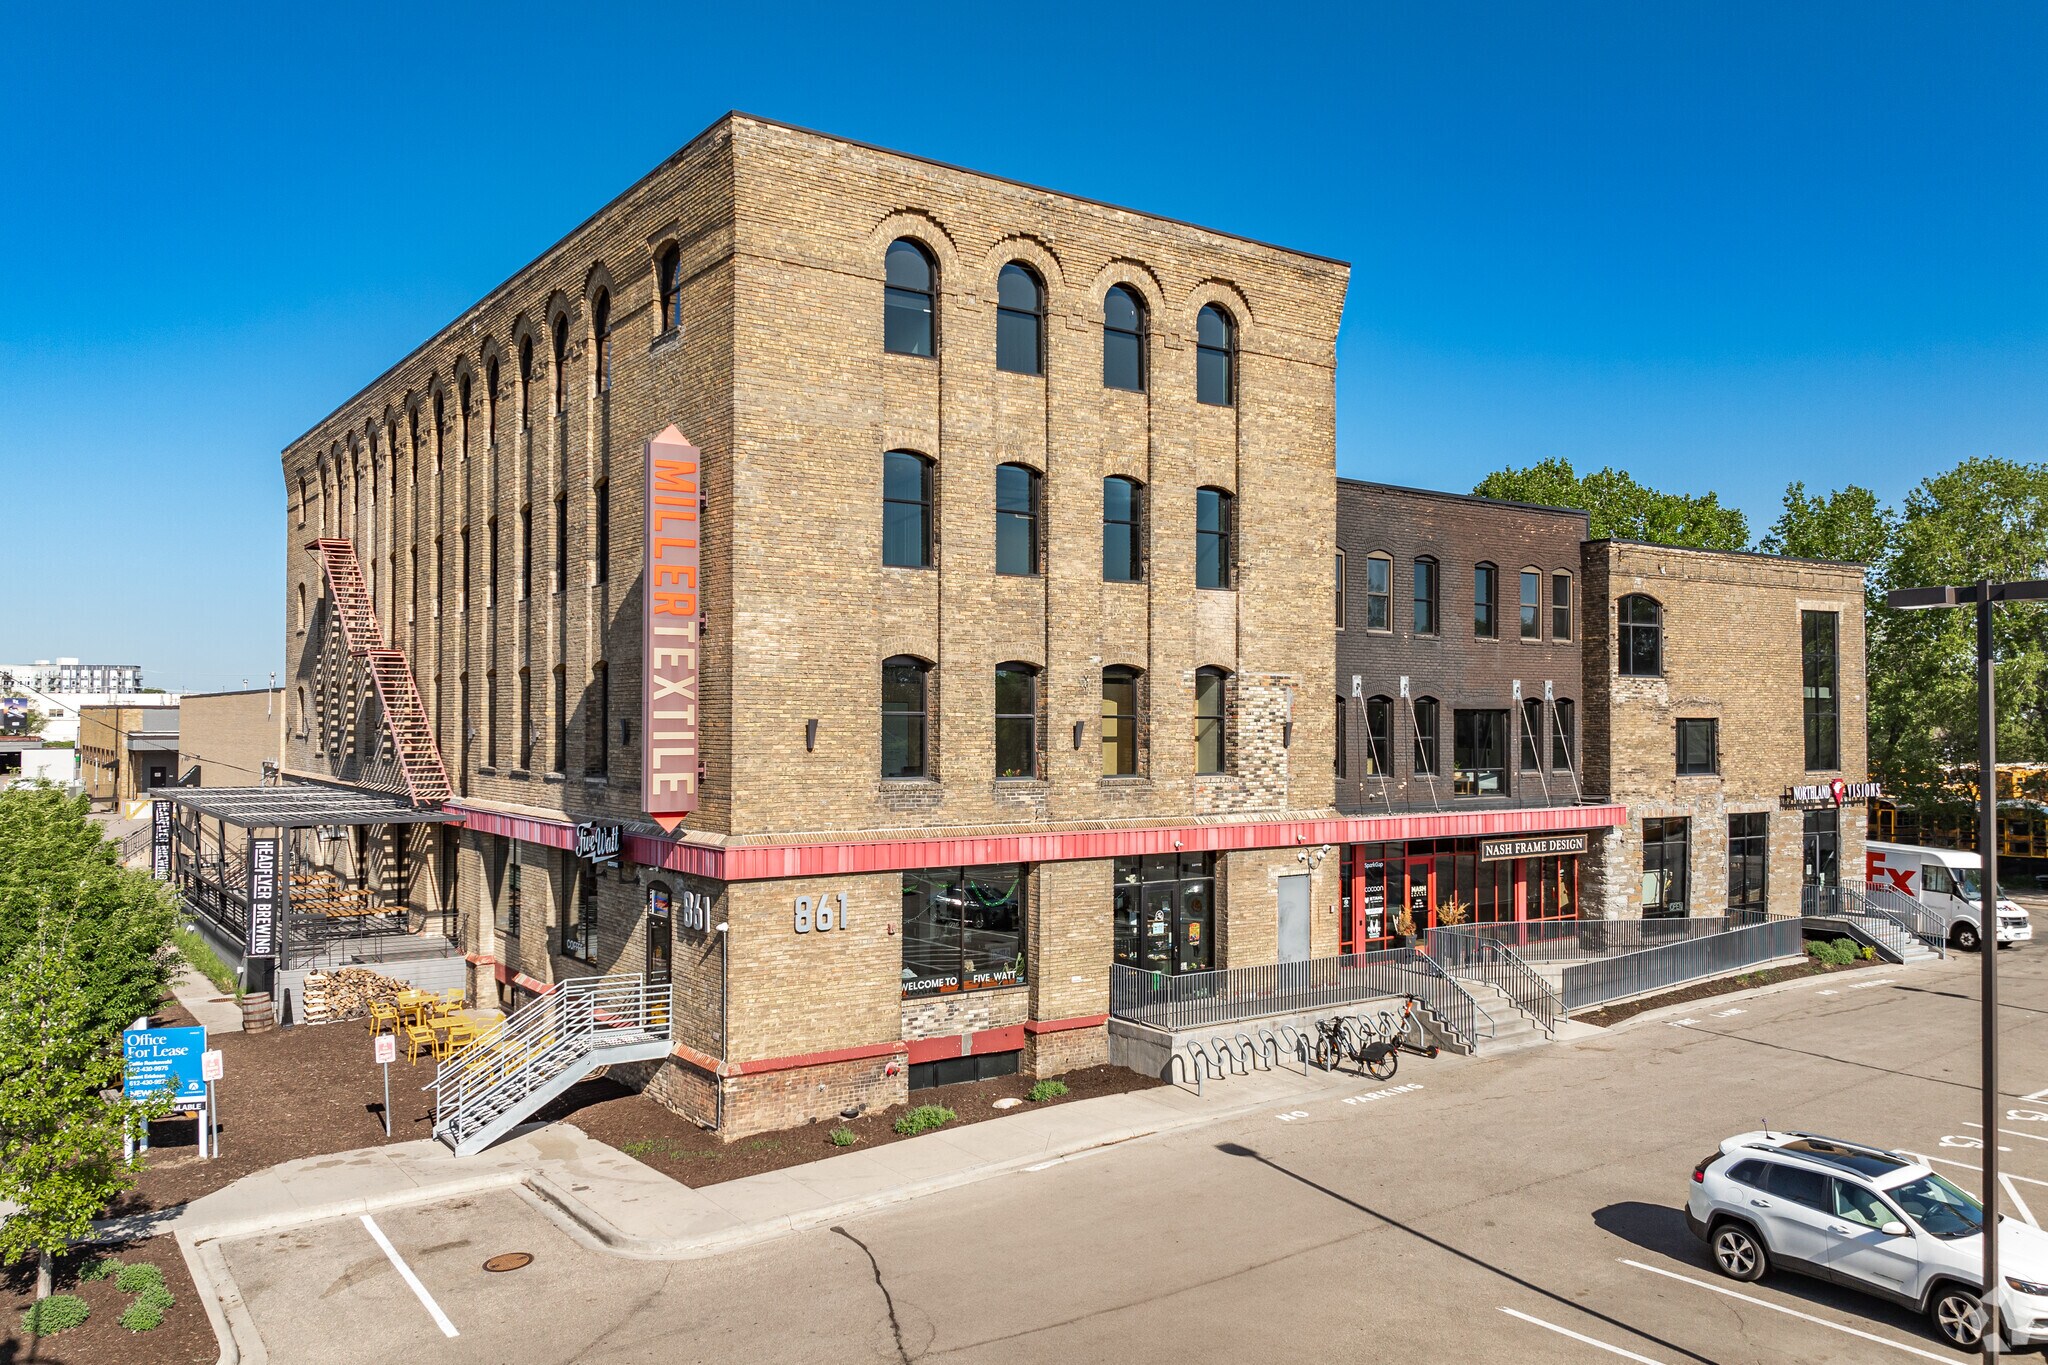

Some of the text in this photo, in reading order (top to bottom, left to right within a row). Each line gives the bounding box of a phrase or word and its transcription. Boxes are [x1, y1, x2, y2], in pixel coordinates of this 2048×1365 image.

[653, 459, 696, 795] MILLER TEXTILE
[1793, 783, 1881, 800] NORTHLAND VISIONS
[576, 822, 619, 857] Five Watt
[1486, 839, 1583, 856] NASH FRAME DESIGN
[255, 841, 274, 954] HEADFLYER BREWING
[684, 891, 710, 933] 861
[794, 892, 847, 933] 861
[902, 971, 1017, 991] WELCOME TO FIVE WATT
[127, 1034, 167, 1046] Office
[127, 1045, 189, 1058] For Lease
[1275, 1083, 1424, 1121] NO PARKING
